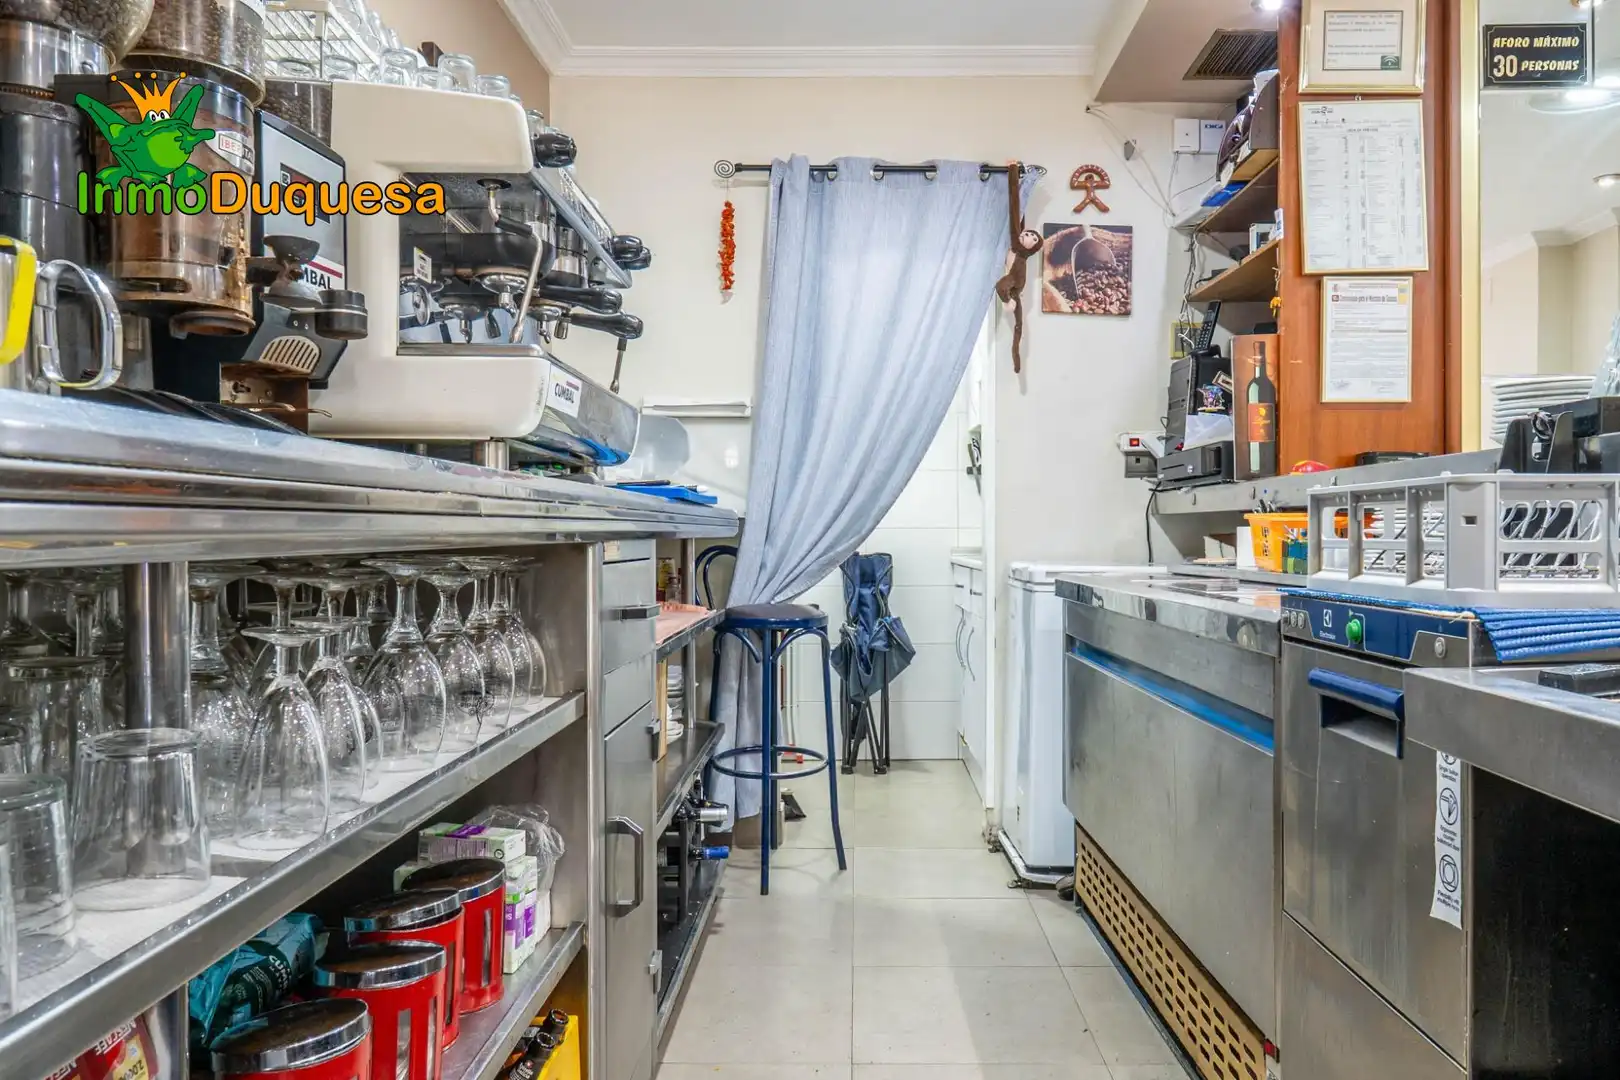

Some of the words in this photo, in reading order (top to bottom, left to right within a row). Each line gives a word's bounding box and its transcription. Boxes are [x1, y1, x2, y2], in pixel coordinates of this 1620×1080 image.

[1493, 37, 1529, 48] AFORO
[1533, 35, 1580, 48] MÁXIMO
[1493, 54, 1518, 77] 30
[1521, 60, 1580, 71] PERSONAS
